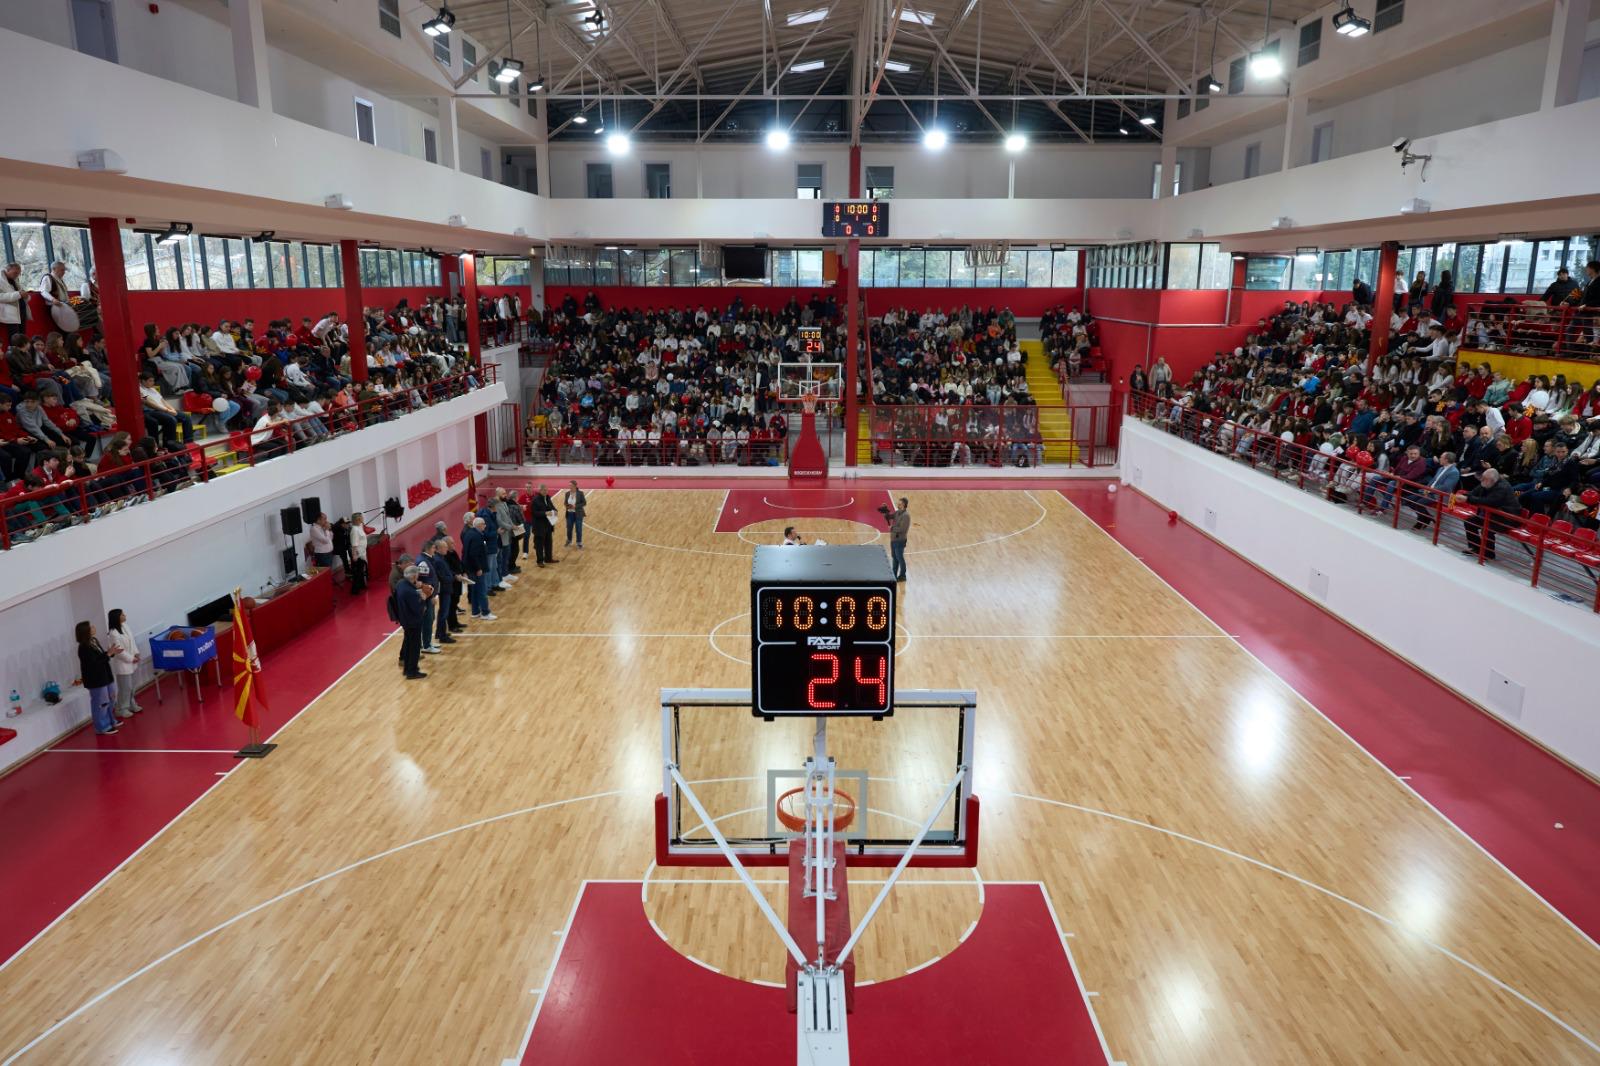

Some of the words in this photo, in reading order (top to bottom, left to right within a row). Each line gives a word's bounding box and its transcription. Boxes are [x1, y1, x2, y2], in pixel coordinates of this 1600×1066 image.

[845, 225, 852, 235] 0
[867, 225, 874, 235] 0
[801, 331, 821, 339] 10:00
[806, 341, 821, 352] 24
[775, 596, 887, 630] 10:00
[807, 636, 841, 646] FAZI
[808, 653, 886, 709] 24
